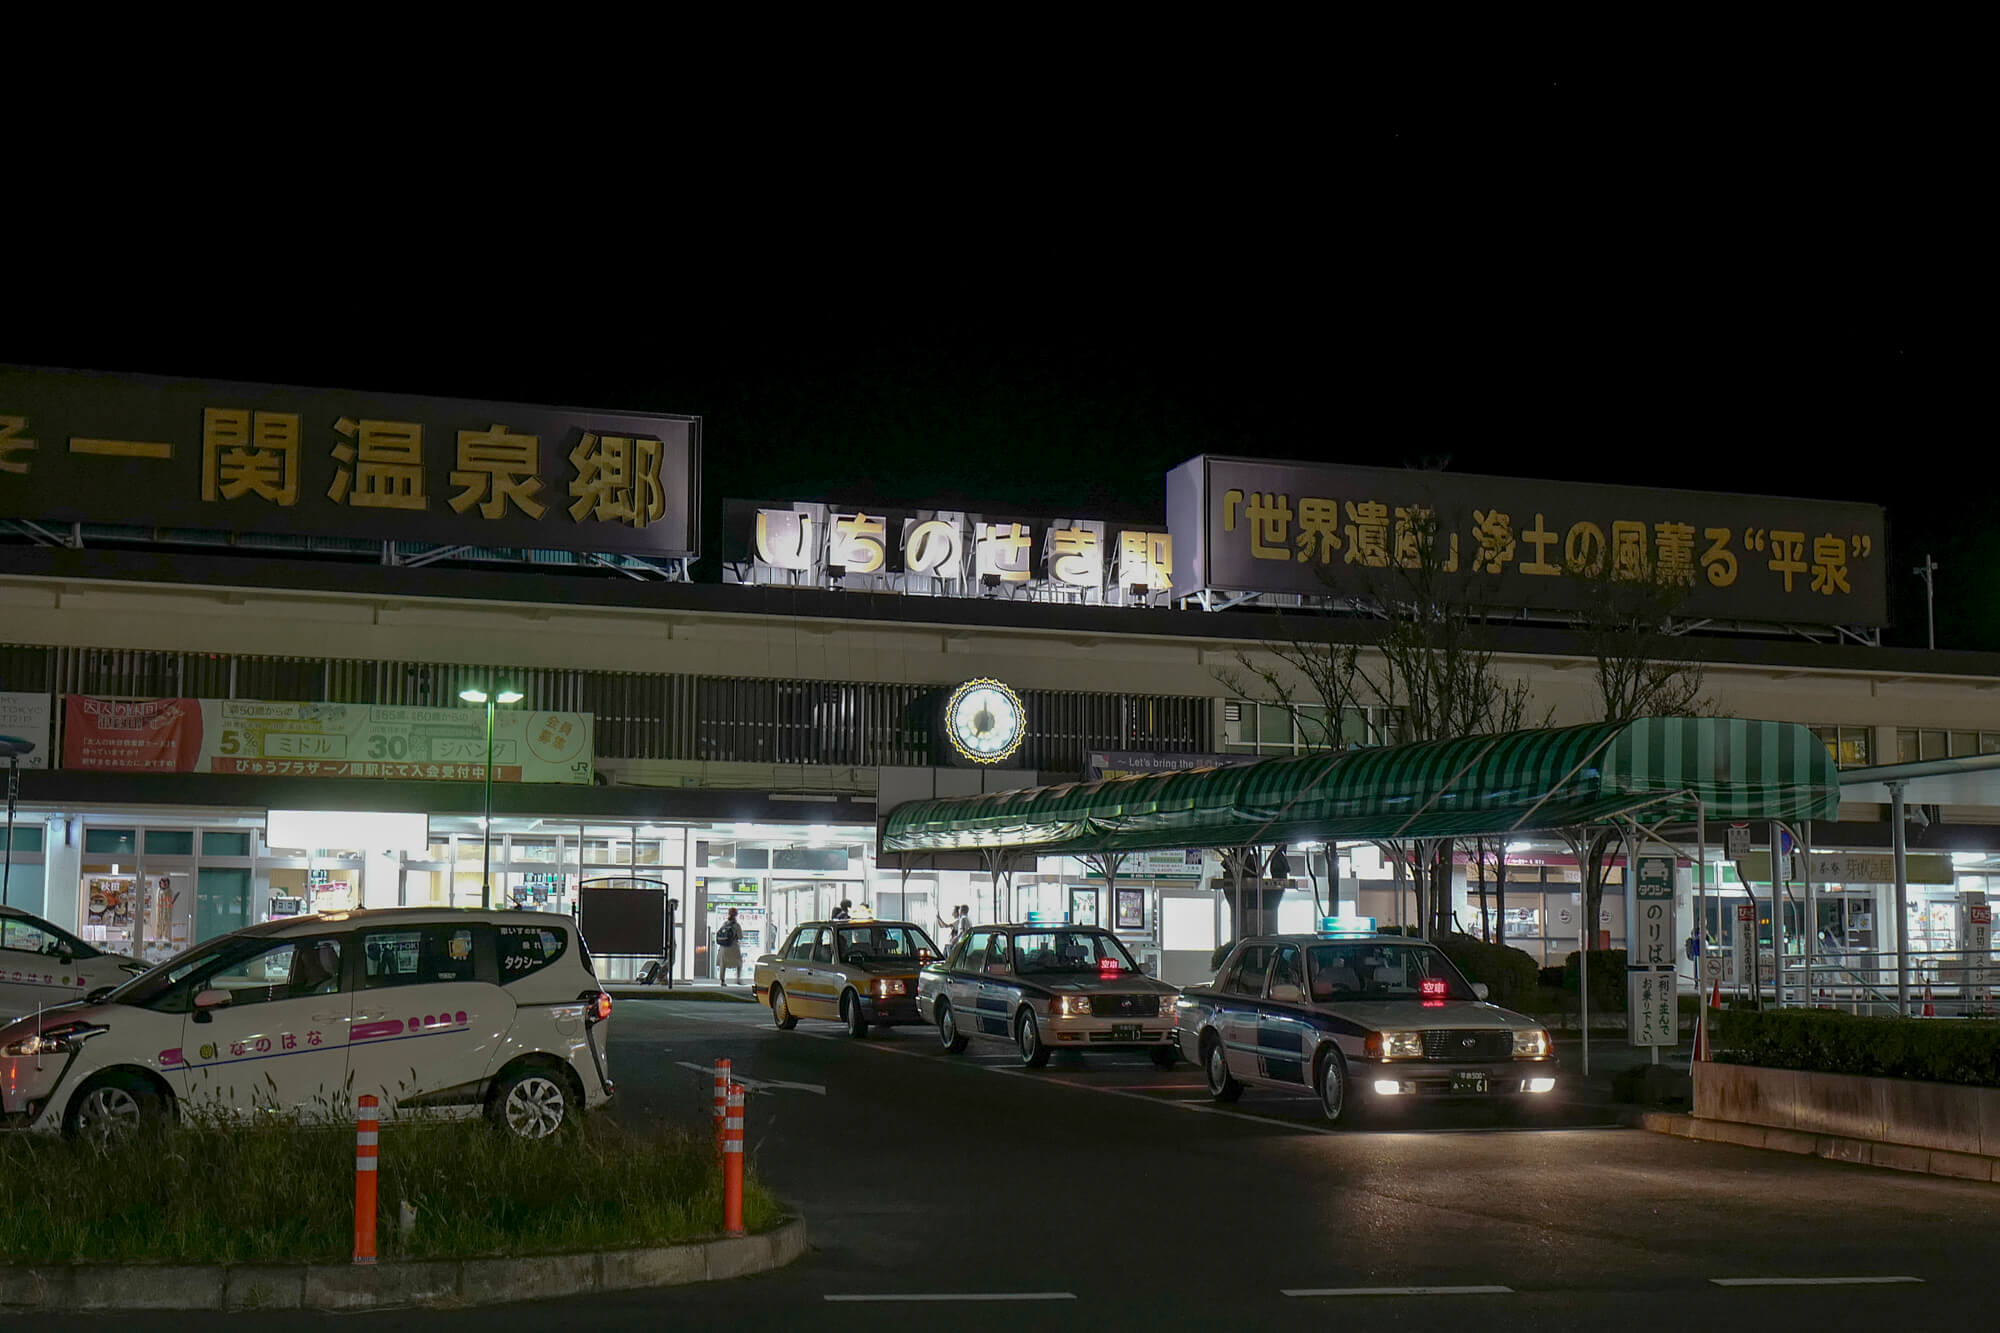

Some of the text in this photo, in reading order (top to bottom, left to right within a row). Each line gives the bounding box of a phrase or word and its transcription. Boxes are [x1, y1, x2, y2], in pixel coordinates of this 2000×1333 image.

[756, 512, 1173, 589] いちのせき駅
[279, 736, 332, 753] ミドル
[571, 761, 589, 772] JR
[1129, 757, 1150, 767] Let's
[1153, 757, 1177, 769] bring
[1179, 758, 1194, 768] the
[1638, 884, 1672, 896] タクシー
[1647, 904, 1664, 964] のりば
[504, 955, 543, 970] タクシー
[1423, 981, 1445, 993] 空車
[229, 1030, 323, 1056] なのはな
